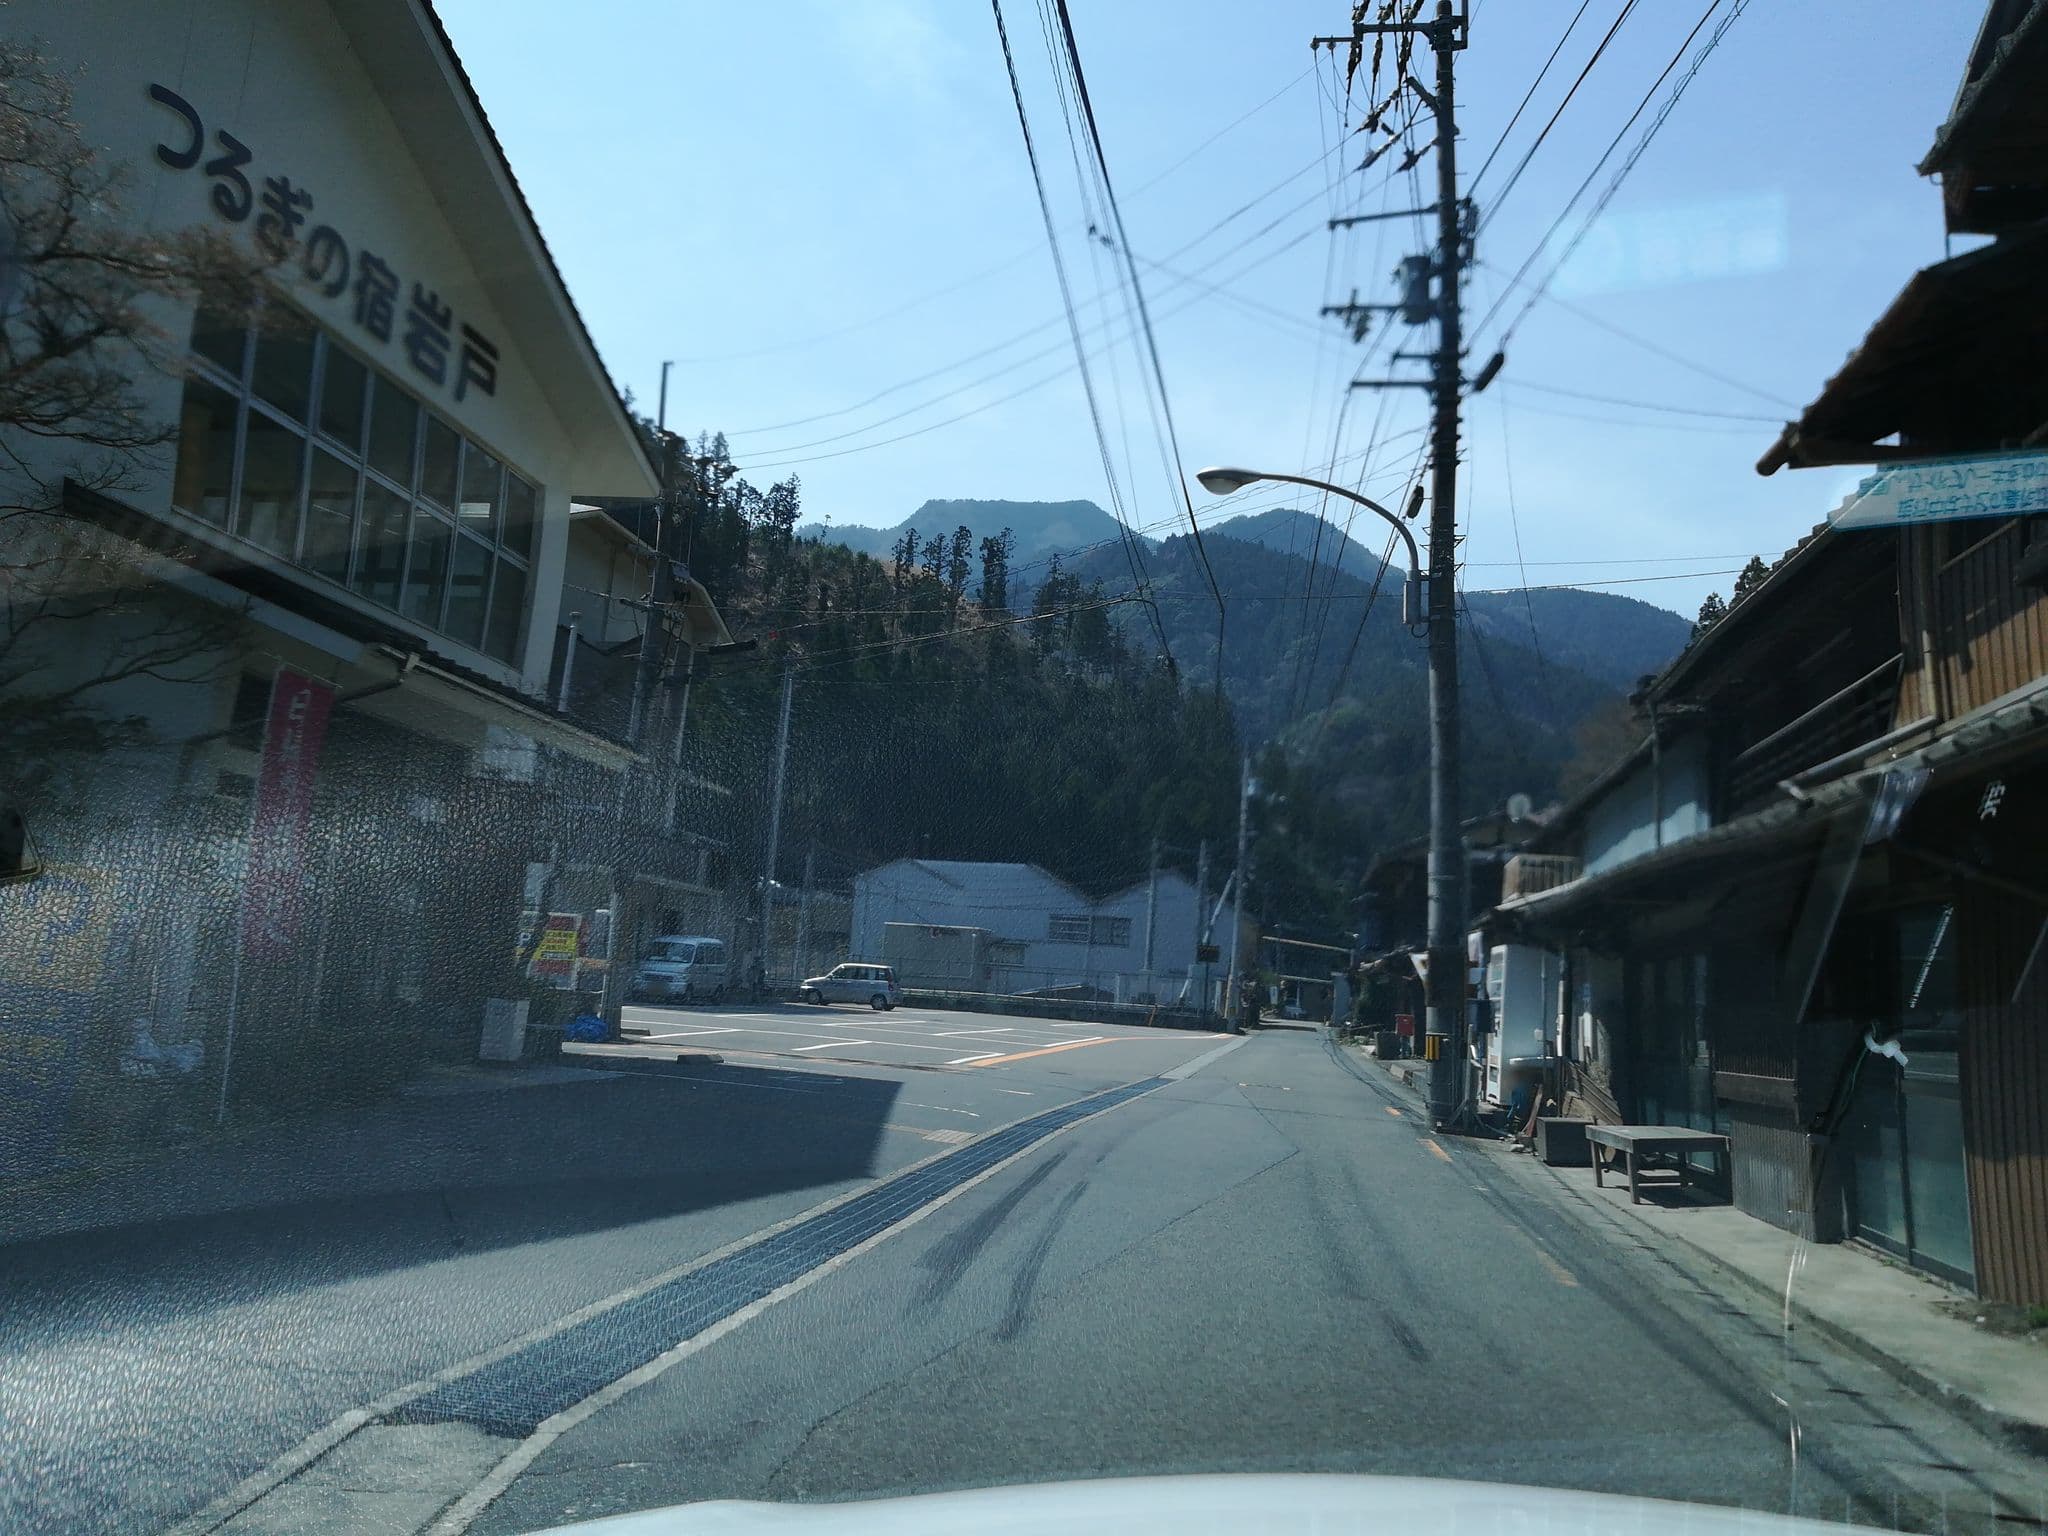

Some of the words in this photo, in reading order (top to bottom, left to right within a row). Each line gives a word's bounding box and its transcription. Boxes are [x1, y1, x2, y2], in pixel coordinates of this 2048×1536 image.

[150, 83, 499, 401] つるぎの宿岩戸
